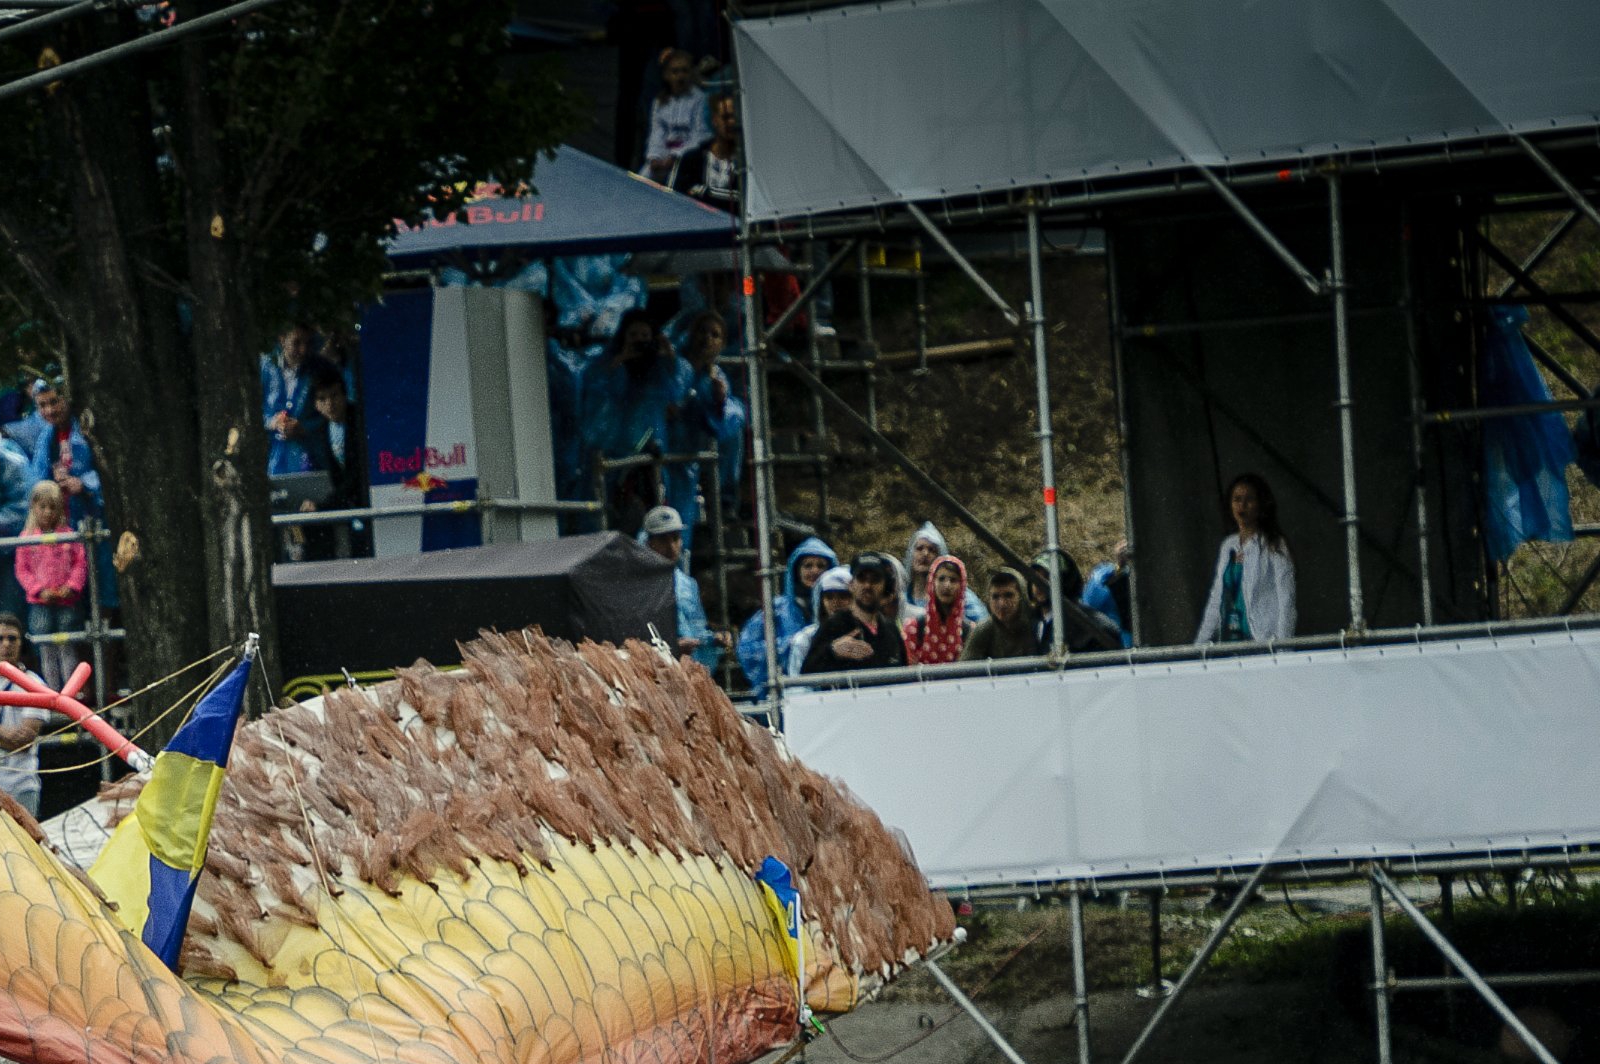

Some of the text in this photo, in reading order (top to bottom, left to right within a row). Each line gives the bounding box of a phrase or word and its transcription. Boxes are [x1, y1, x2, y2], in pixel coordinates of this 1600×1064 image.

[466, 203, 544, 225] Bull
[379, 443, 466, 474] Red Bull
